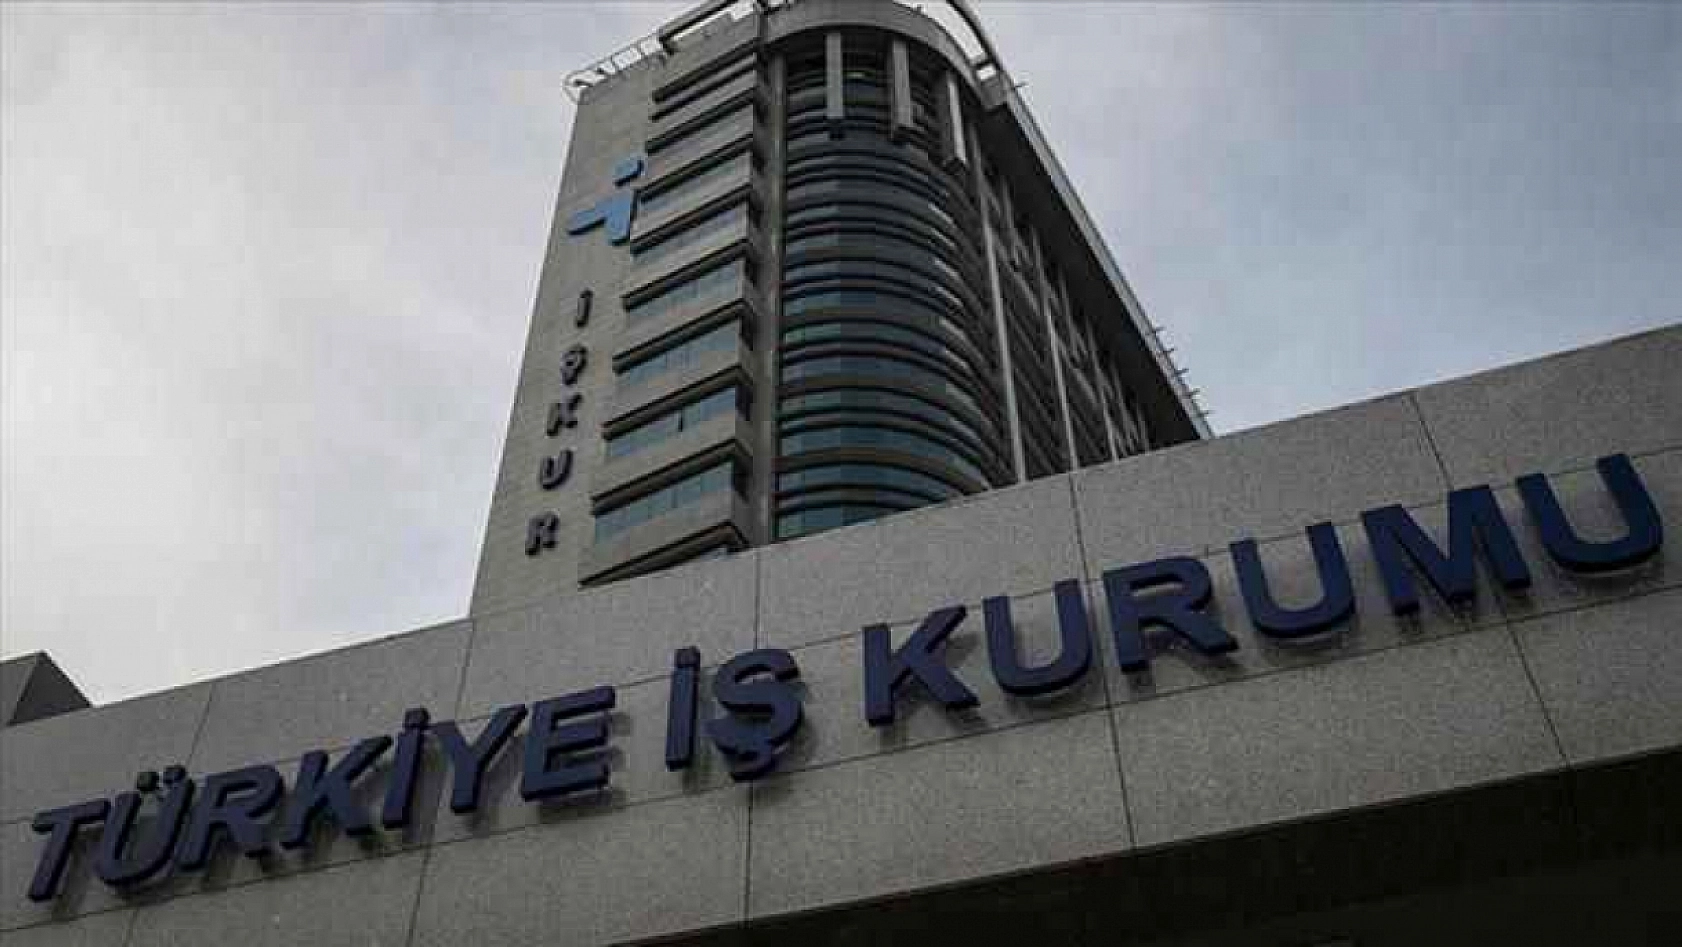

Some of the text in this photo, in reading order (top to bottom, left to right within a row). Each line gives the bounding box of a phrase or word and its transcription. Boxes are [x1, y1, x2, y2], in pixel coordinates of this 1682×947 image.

[524, 289, 593, 557] İŞKUR
[27, 453, 1664, 903] TÜRKİYE İŞ KURUMU
